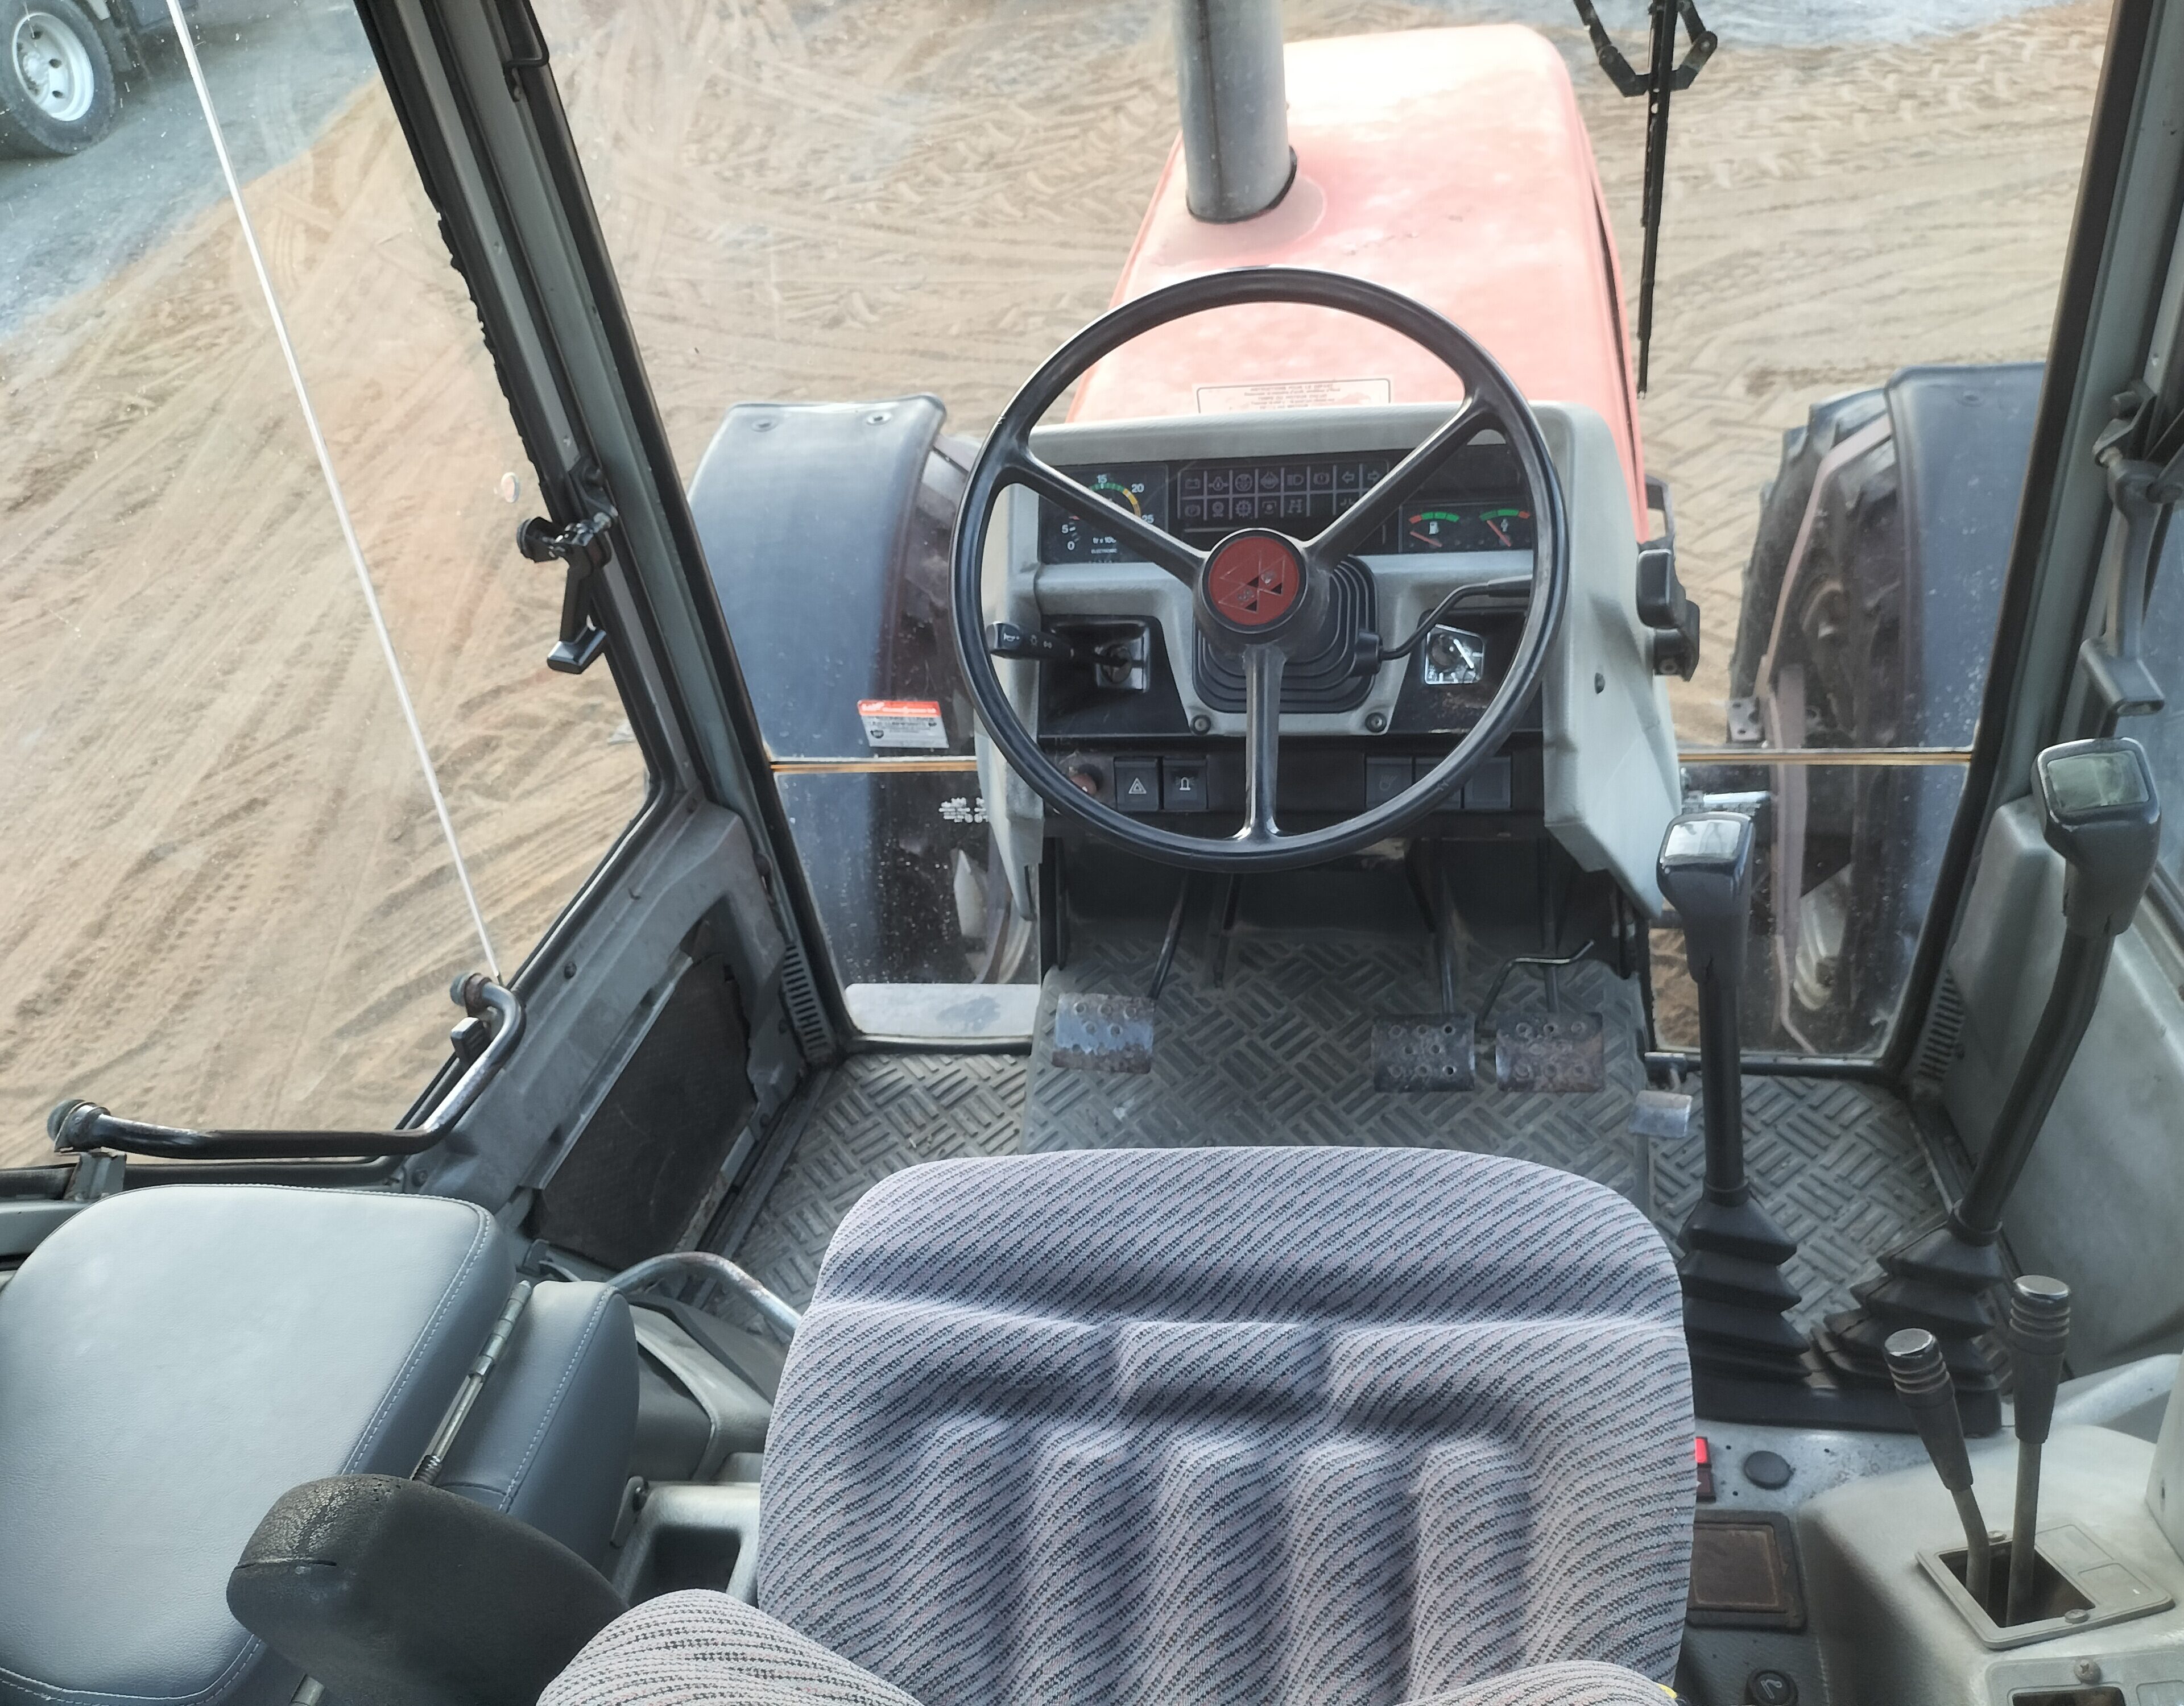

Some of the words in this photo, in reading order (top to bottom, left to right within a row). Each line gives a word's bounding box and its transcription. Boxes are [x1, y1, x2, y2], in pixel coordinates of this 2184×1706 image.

[1097, 474, 1107, 483] 15
[1131, 483, 1144, 492] 20
[1061, 524, 1069, 533] 5
[1067, 541, 1075, 550] 0
